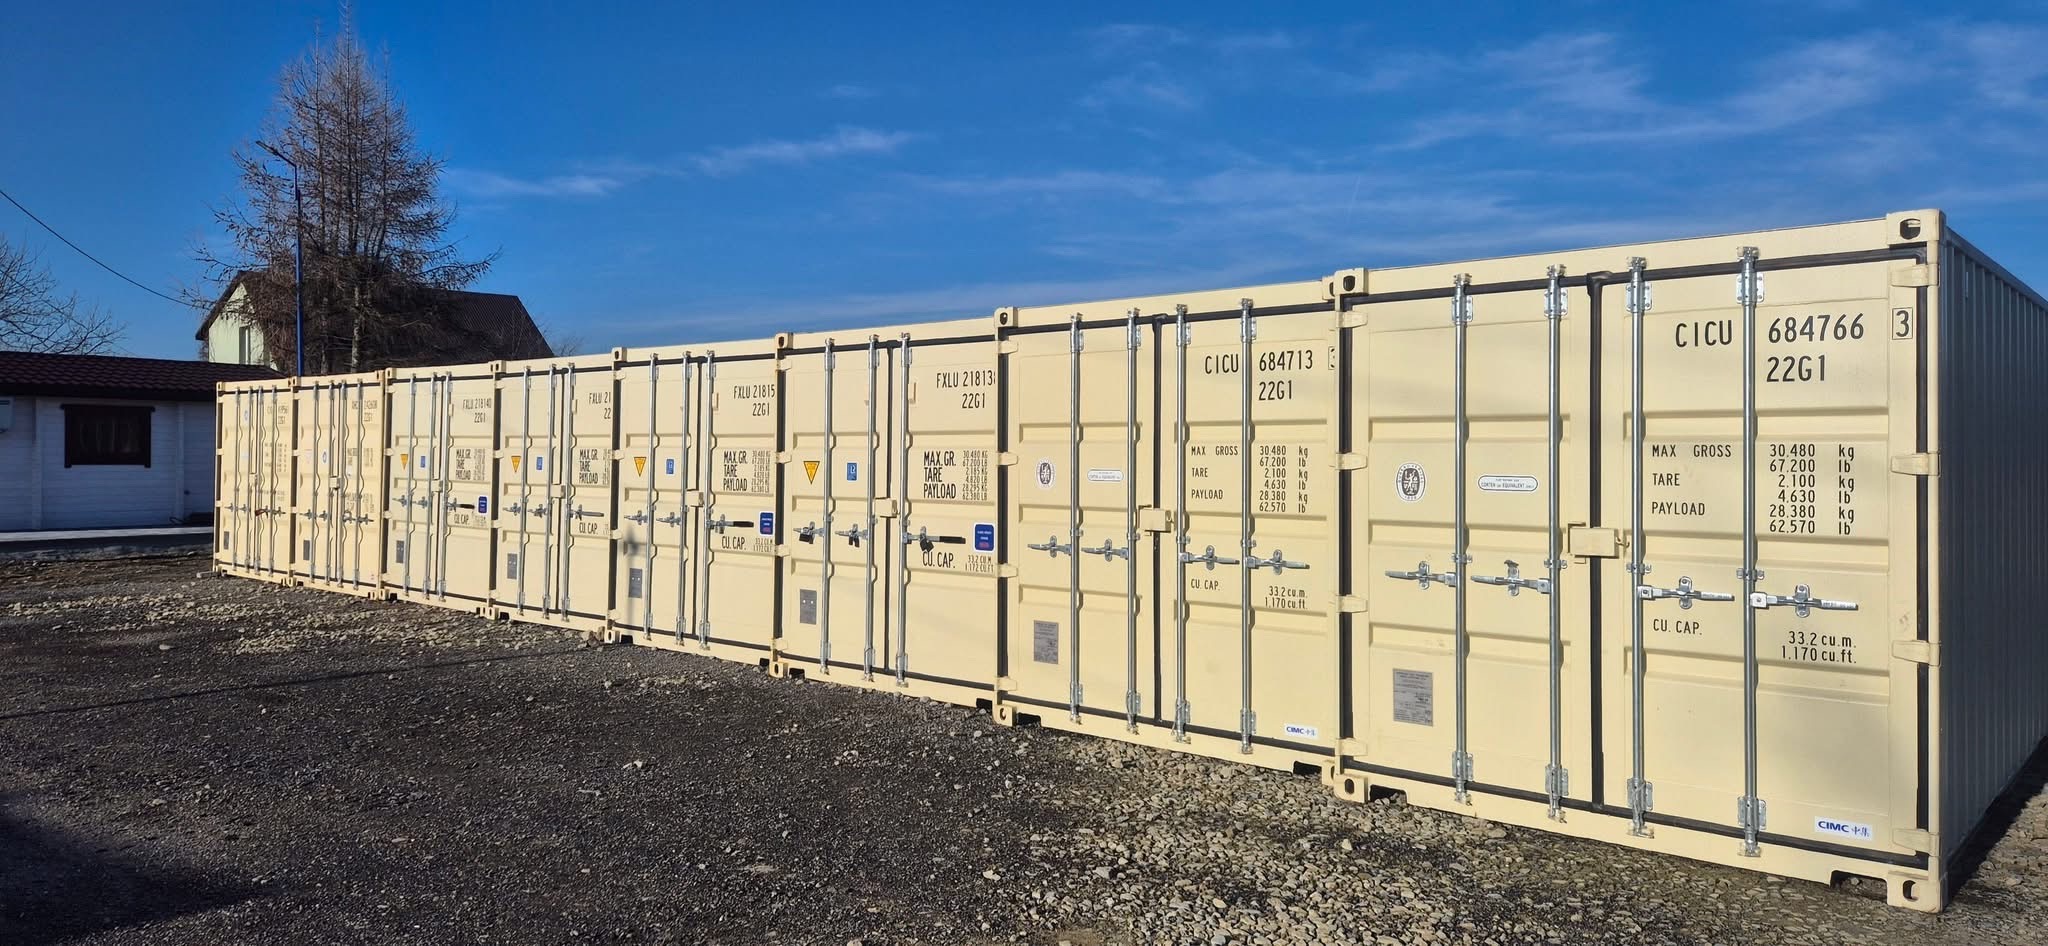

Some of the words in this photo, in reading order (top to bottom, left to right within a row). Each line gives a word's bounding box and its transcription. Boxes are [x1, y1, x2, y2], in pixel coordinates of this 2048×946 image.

[1676, 320, 1733, 347] CICU
[1768, 313, 1864, 344] 684766
[1896, 310, 1910, 338] 3
[1205, 354, 1239, 374] CICU
[1259, 350, 1313, 371] 684713
[1766, 355, 1826, 383] 22G1
[936, 372, 959, 388] FXLU
[963, 369, 996, 387] 21813
[734, 385, 750, 399] FXLU
[753, 384, 775, 398] 21815
[1258, 380, 1293, 400] 22G1
[589, 393, 602, 405] FXLU
[962, 392, 985, 409] 22G1
[752, 403, 770, 417] 22G1
[1191, 446, 1206, 456] MAX
[1215, 446, 1238, 456] GROSS
[1260, 445, 1286, 455] 30.480
[1299, 446, 1308, 458] kg
[1652, 445, 1677, 458] MAX
[1693, 445, 1732, 458] GROSS
[1769, 444, 1816, 458] 30.480
[1838, 444, 1855, 461] kg
[1260, 457, 1286, 467] 67.200
[1299, 458, 1306, 467] lb
[1769, 459, 1816, 473] 67.200
[1838, 460, 1851, 473] lb
[579, 472, 598, 484] PAYLOAD
[724, 464, 737, 478] TARE
[924, 467, 942, 482] TARE
[1192, 468, 1208, 478] TARE
[1265, 469, 1286, 478] 2.100
[1299, 469, 1308, 480] kg
[723, 478, 748, 492] PAYLOAD
[1264, 480, 1286, 490] 4.630
[1299, 481, 1306, 490] lb
[1652, 473, 1681, 487] TARE
[1778, 474, 1816, 488] 2.100
[1838, 475, 1855, 492] kg
[923, 483, 956, 499] PAYLOAD
[1191, 489, 1224, 500] PAYLOAD
[1260, 491, 1286, 501] 28.380
[1299, 492, 1308, 504] kg
[1778, 490, 1816, 503] 4.630
[1838, 491, 1851, 504] lb
[1260, 502, 1286, 512] 62.570
[1299, 503, 1306, 513] lb
[1652, 502, 1705, 516] PAYLOAD
[1769, 505, 1816, 519] 28.380
[1838, 506, 1855, 523] kg
[1769, 520, 1816, 534] 62.570
[1838, 522, 1851, 535] lb
[733, 536, 746, 551] CAP.
[922, 551, 936, 567] CU.
[938, 552, 956, 568] CAP.
[1190, 578, 1202, 589] CU.
[1204, 580, 1221, 591] CAP.
[1269, 586, 1286, 597] 33.2
[1265, 597, 1286, 608] 1.170
[1653, 619, 1671, 633] CU.
[1676, 620, 1703, 635] CAP.
[1788, 631, 1817, 646] 33.2
[1821, 634, 1857, 648] cu.m.
[1781, 646, 1817, 662] 1.170
[1821, 649, 1857, 664] cu.ft.
[1818, 820, 1850, 833] CIMC
